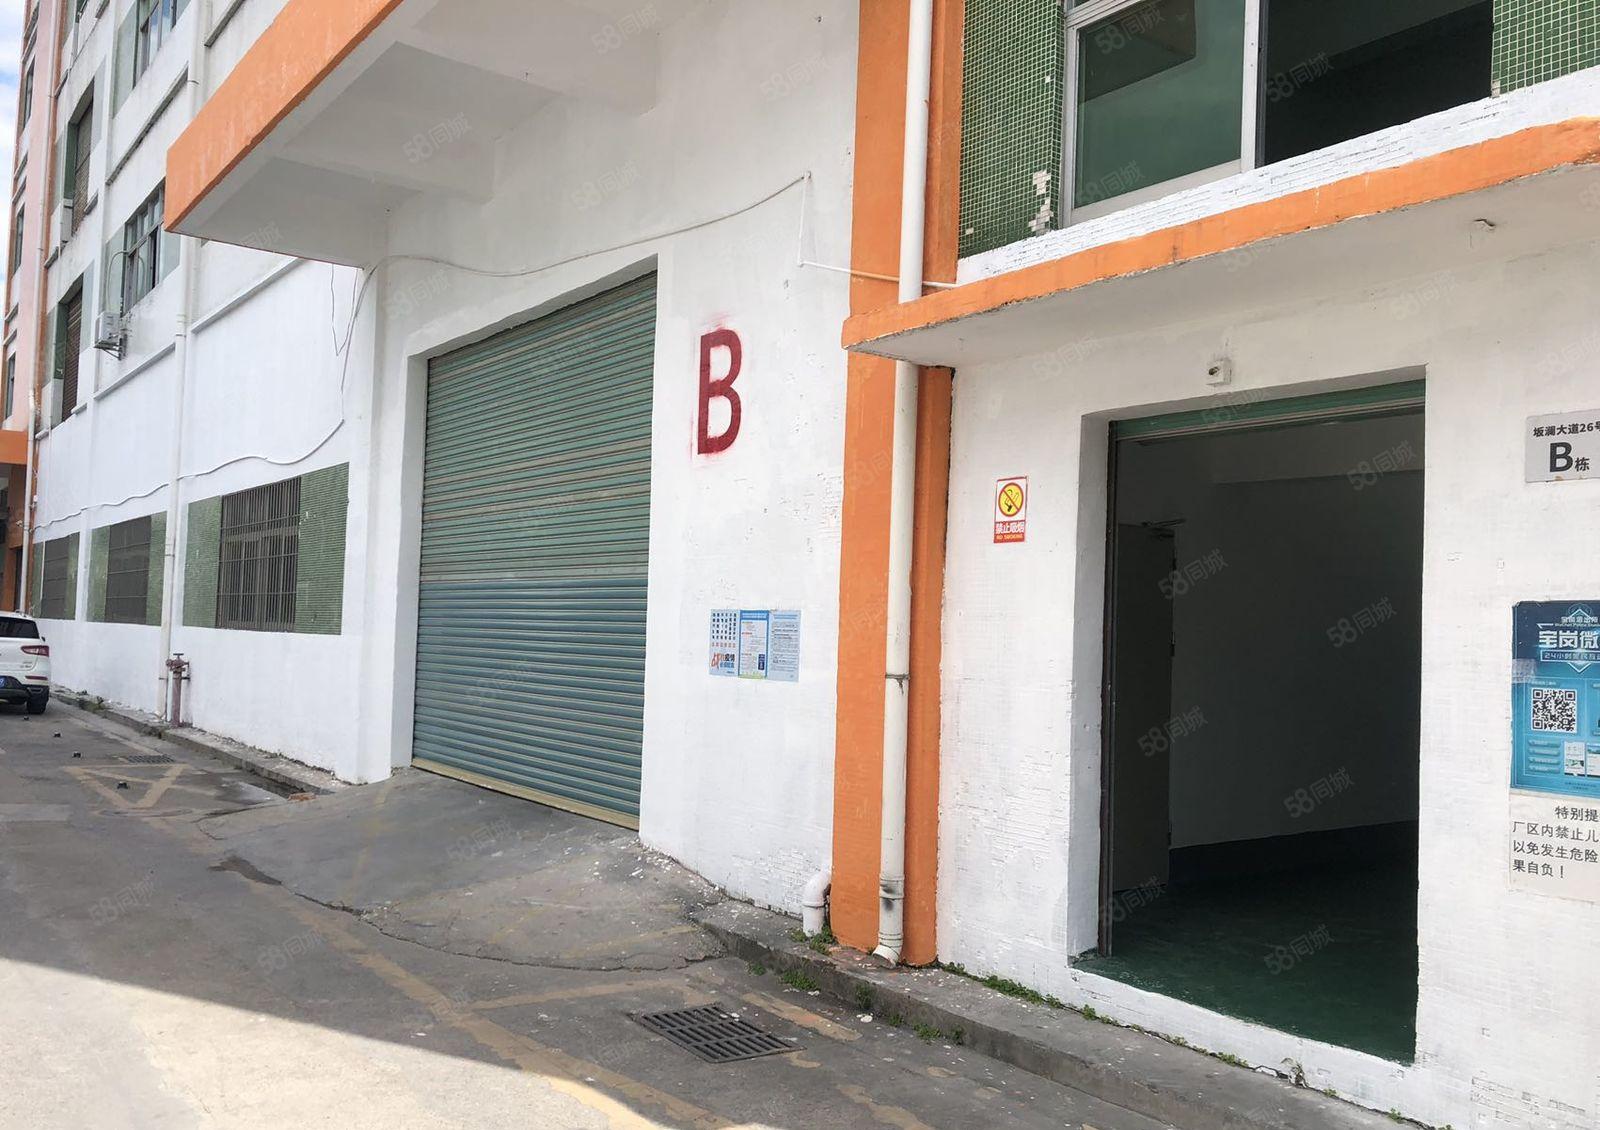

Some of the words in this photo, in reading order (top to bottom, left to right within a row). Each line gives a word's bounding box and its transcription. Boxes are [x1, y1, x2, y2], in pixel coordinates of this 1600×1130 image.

[697, 329, 742, 455] B
[1538, 630, 1599, 649] 宝岗微
[1512, 820, 1599, 843] 厂区内禁止儿
[1513, 839, 1599, 864] 以免发生危险
